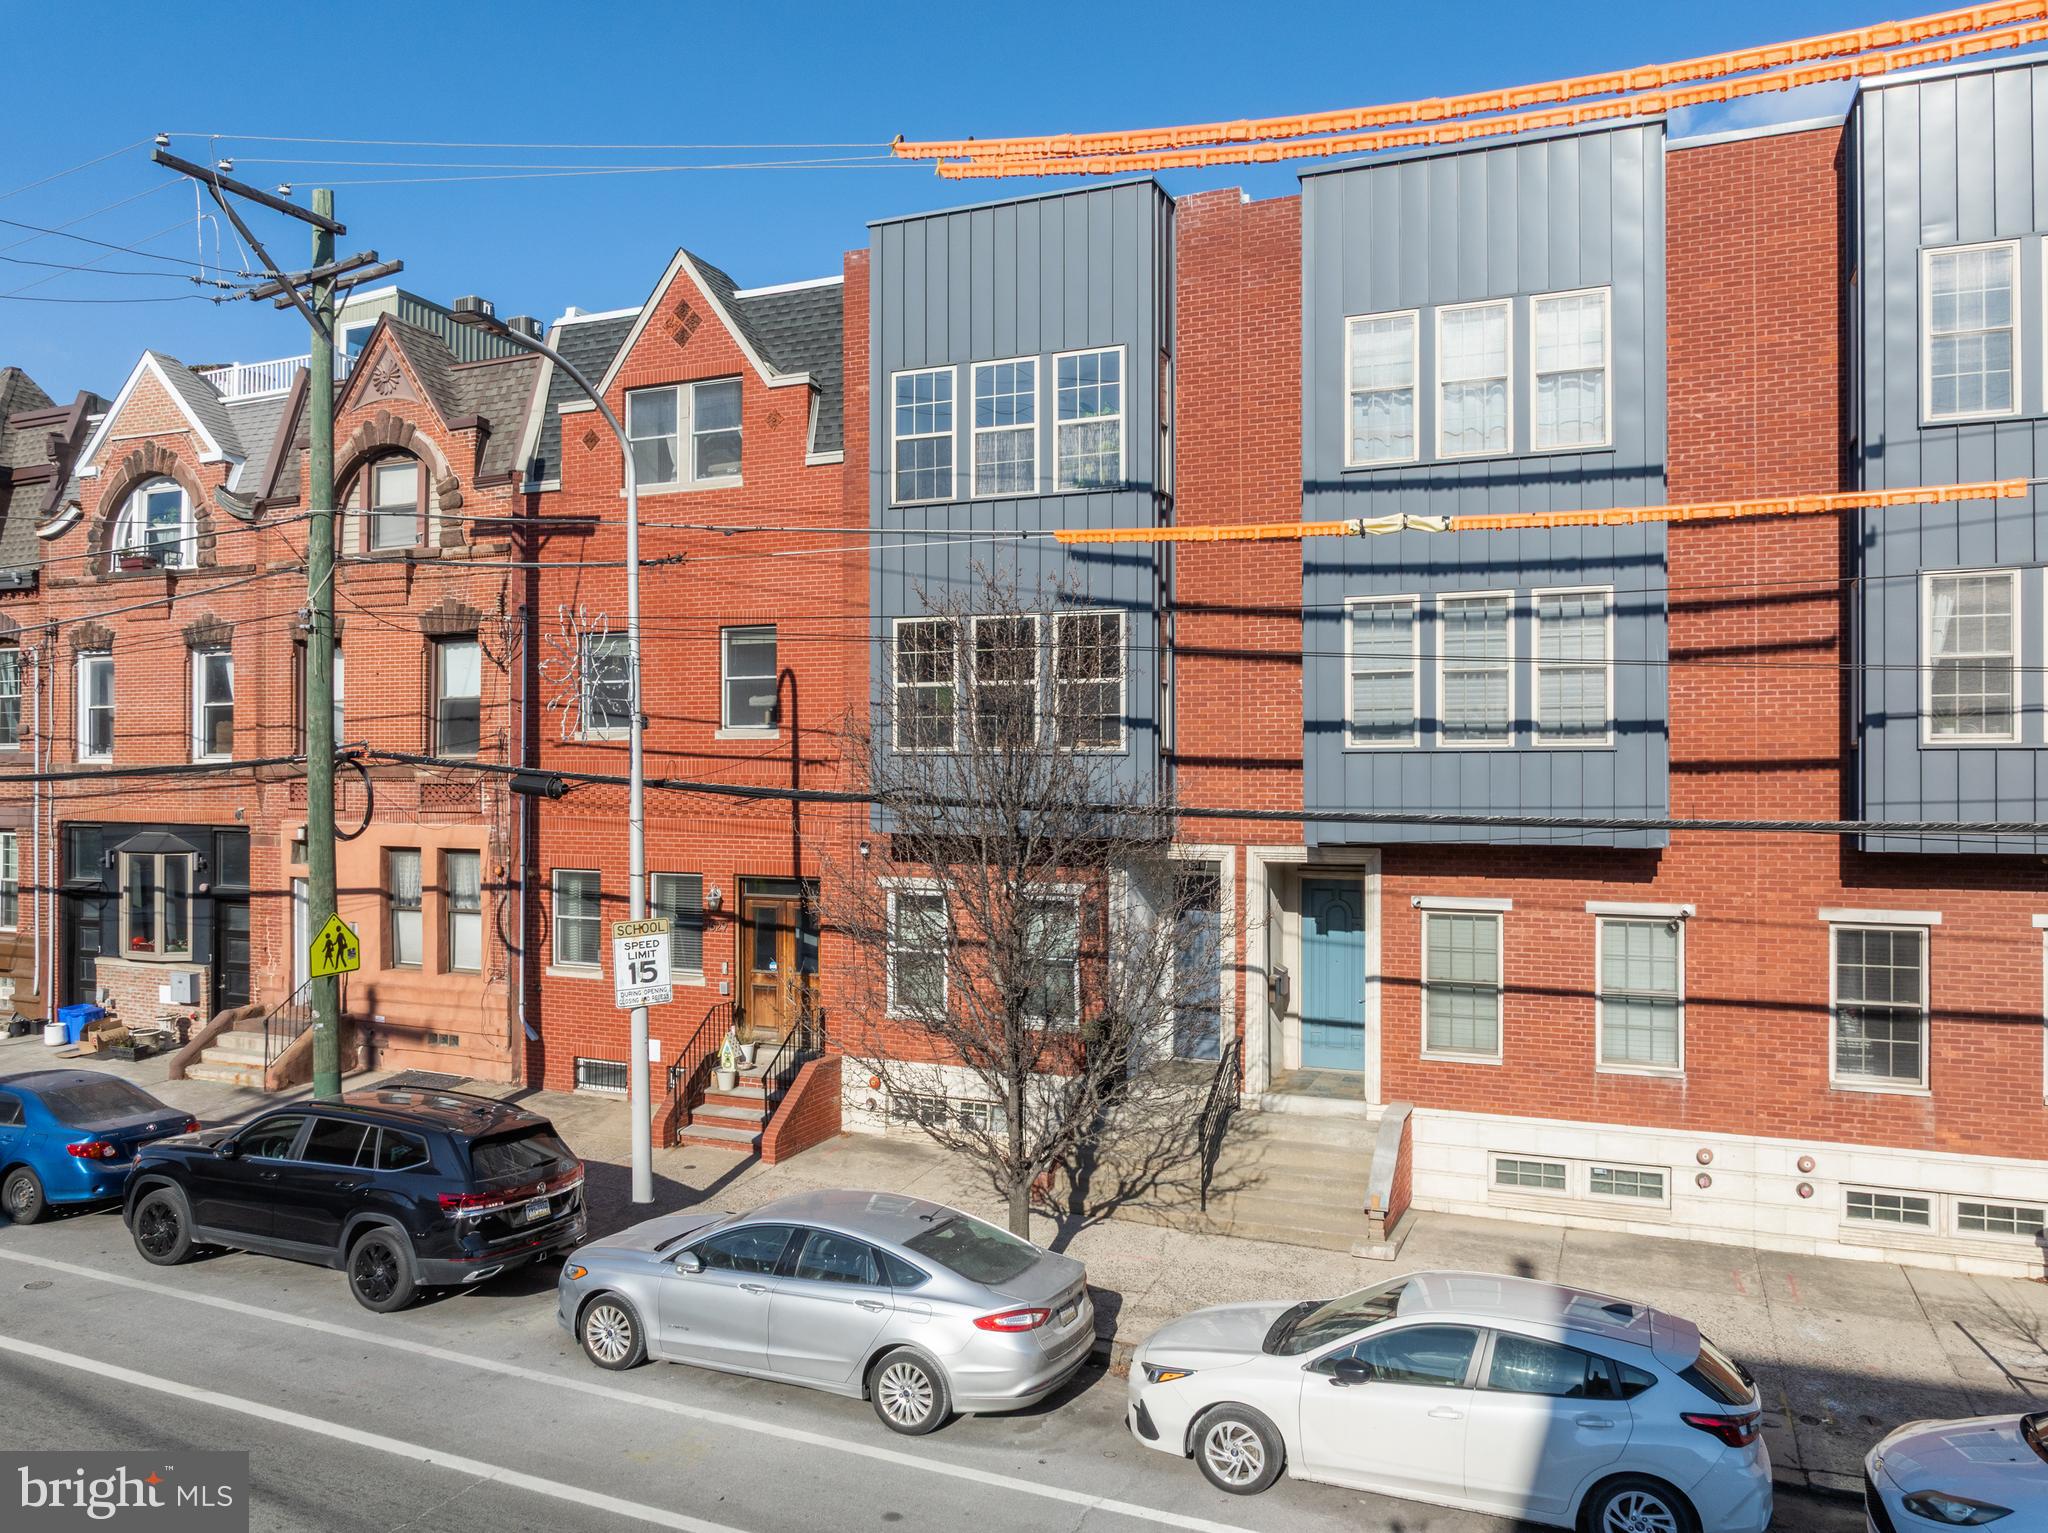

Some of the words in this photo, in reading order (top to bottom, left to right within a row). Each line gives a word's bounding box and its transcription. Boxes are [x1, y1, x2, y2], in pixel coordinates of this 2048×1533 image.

[617, 922, 665, 936] SCHOOL
[624, 939, 660, 951] SPEED
[628, 949, 657, 961] LIMIT
[628, 960, 658, 985] 15
[620, 990, 642, 998] DURING
[644, 986, 668, 995] OPENING
